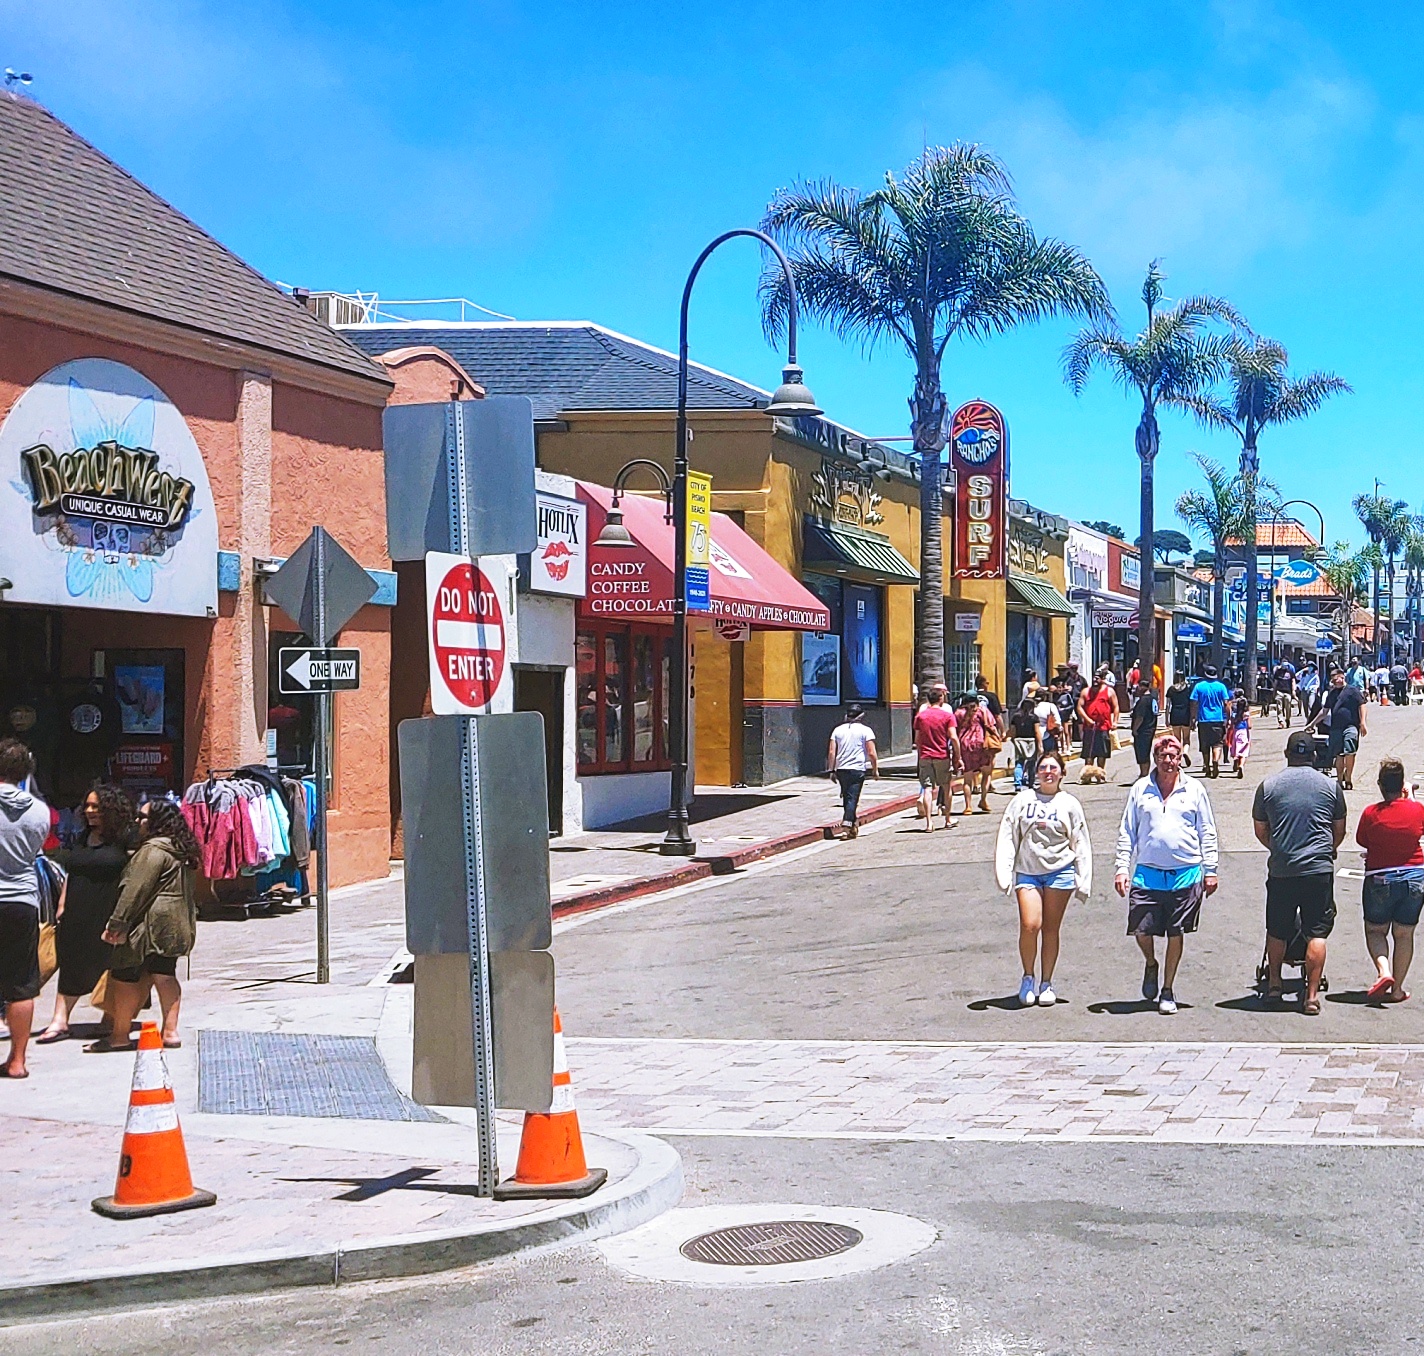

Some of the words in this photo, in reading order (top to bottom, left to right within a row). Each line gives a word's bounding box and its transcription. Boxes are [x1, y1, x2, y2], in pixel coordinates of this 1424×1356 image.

[69, 499, 103, 514] UNIQUE
[105, 503, 137, 520] CASUAL
[139, 508, 163, 523] WEAR
[968, 475, 993, 568] SURF
[592, 563, 645, 575] CANDY
[1281, 565, 1313, 579] Brad's
[592, 582, 650, 593] COFFEE
[1232, 591, 1268, 601] CAE
[441, 587, 461, 613] DO
[468, 590, 494, 616] NOT
[592, 600, 675, 612] CHOCOLAT
[731, 602, 757, 619] CANDY
[758, 606, 782, 622] APPLES
[788, 609, 826, 626] CHOCOLATE
[309, 662, 330, 678] ONE
[333, 662, 353, 678] WAY
[448, 654, 494, 681] ENTER
[1026, 803, 1058, 822] USA
